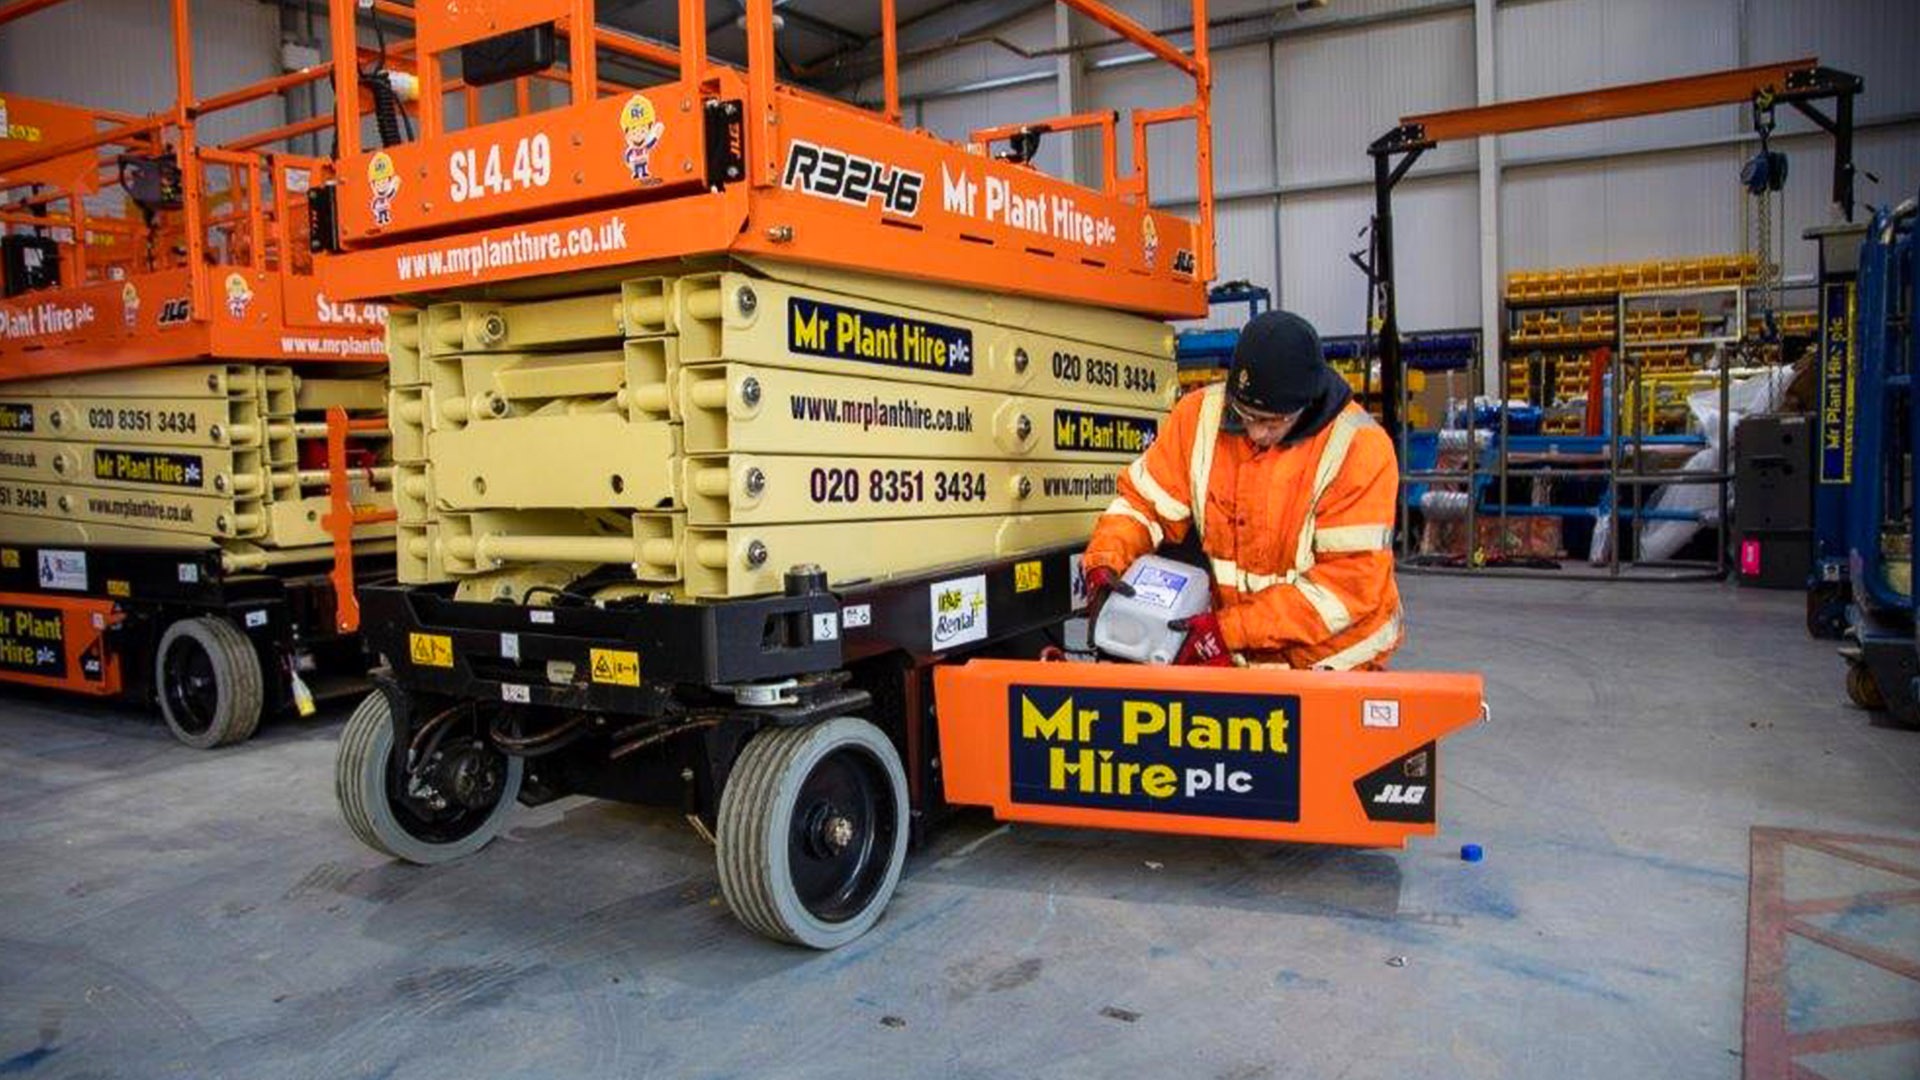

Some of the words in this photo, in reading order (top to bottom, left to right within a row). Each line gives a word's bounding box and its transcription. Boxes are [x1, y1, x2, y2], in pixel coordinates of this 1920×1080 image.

[449, 133, 550, 202] SL4.49
[782, 139, 925, 218] R3246
[941, 161, 979, 215] Mr
[986, 176, 1049, 234] Plant
[1052, 195, 1095, 246] Hire
[1095, 218, 1116, 247] plc
[398, 217, 627, 281] www.mrplanthire.co.uk
[38, 303, 74, 334] Hire
[75, 302, 95, 328] plc
[158, 299, 190, 326] JLG
[793, 304, 829, 351] Mr
[836, 311, 898, 363] Plant
[903, 328, 947, 368] Hire
[949, 335, 971, 366] plc
[1052, 351, 1081, 383] 020
[1086, 356, 1119, 389] 8351
[1124, 363, 1157, 394] 3434
[89, 407, 114, 429] 020
[118, 409, 152, 431] 8351
[158, 411, 197, 434] 3434
[791, 395, 973, 434] www.mrplanthire.co.uk
[1826, 382, 1843, 425] Plant
[1056, 414, 1076, 447] Mr
[1080, 416, 1114, 450] Plant
[1116, 420, 1141, 452] Hire
[96, 453, 114, 476] Mr
[117, 454, 151, 481] Plant
[154, 457, 183, 484] Hire
[811, 467, 859, 503] 020
[870, 469, 924, 503] 8351
[934, 472, 987, 503] 3434
[15, 610, 62, 641] Plant
[1021, 692, 1101, 744] Mr
[1122, 698, 1291, 755] Plant
[1049, 748, 1179, 799] Hire
[1185, 762, 1254, 797] plc
[1374, 783, 1427, 804] JLG
